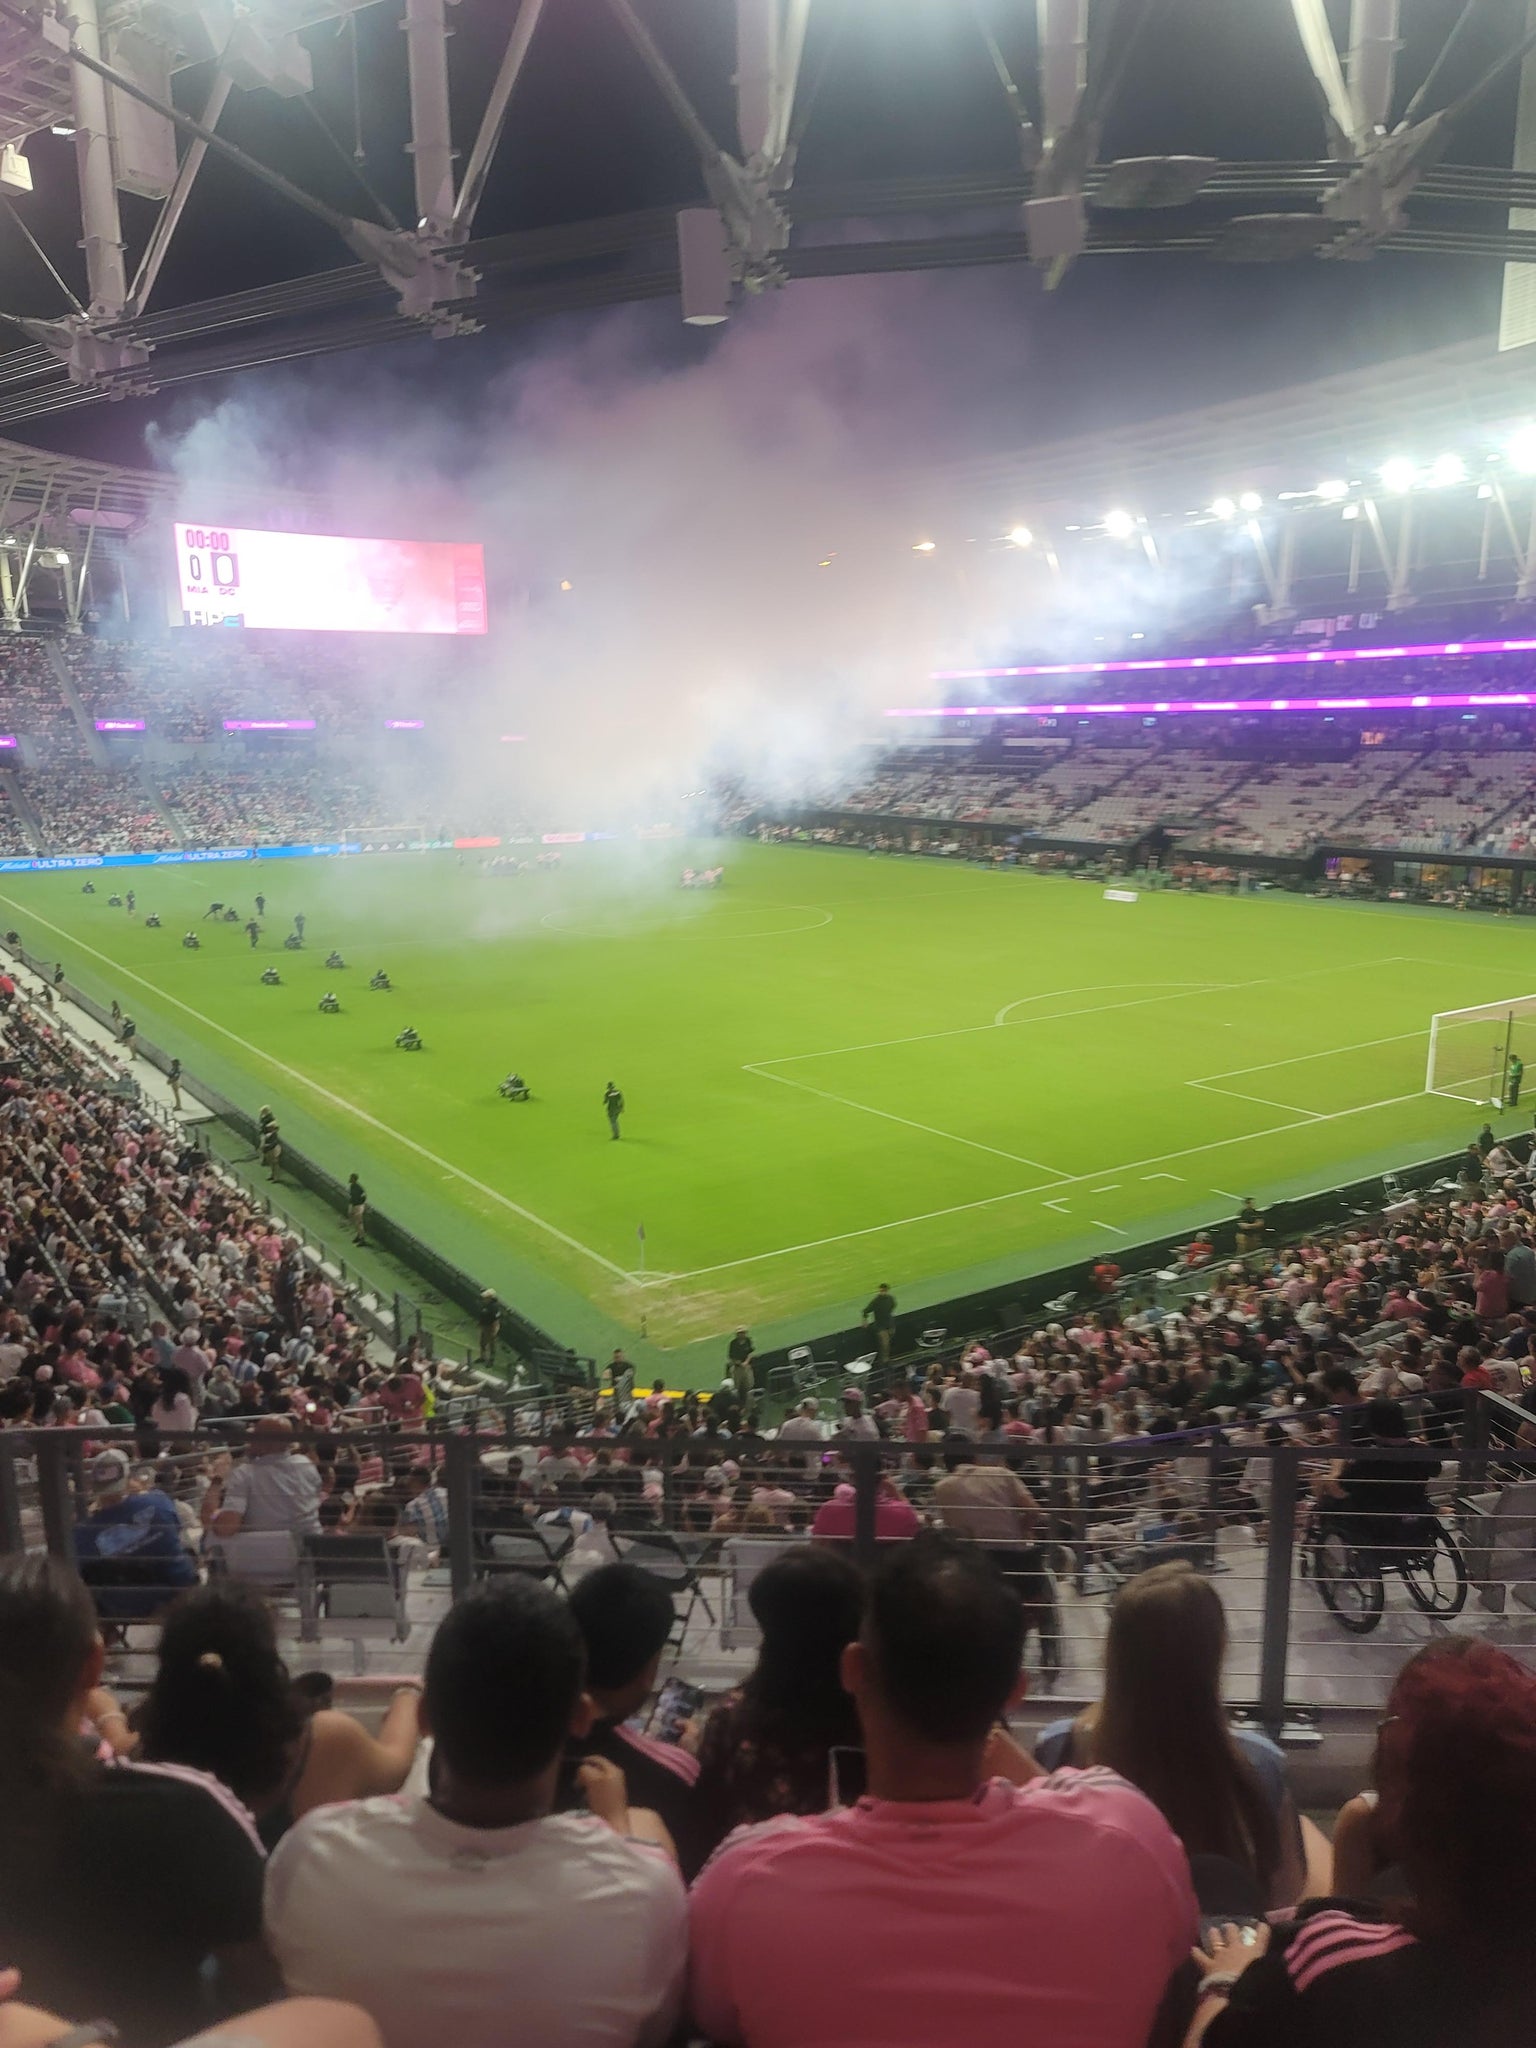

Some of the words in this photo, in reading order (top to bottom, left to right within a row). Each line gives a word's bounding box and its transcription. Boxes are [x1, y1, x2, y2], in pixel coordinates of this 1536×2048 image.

[186, 529, 230, 551] 00:00
[190, 554, 201, 581] 0
[187, 585, 208, 594] MIA
[219, 587, 236, 596] DC
[189, 851, 220, 861] ULTRA
[37, 858, 73, 869] ULTRA
[73, 857, 104, 867] ZERO
